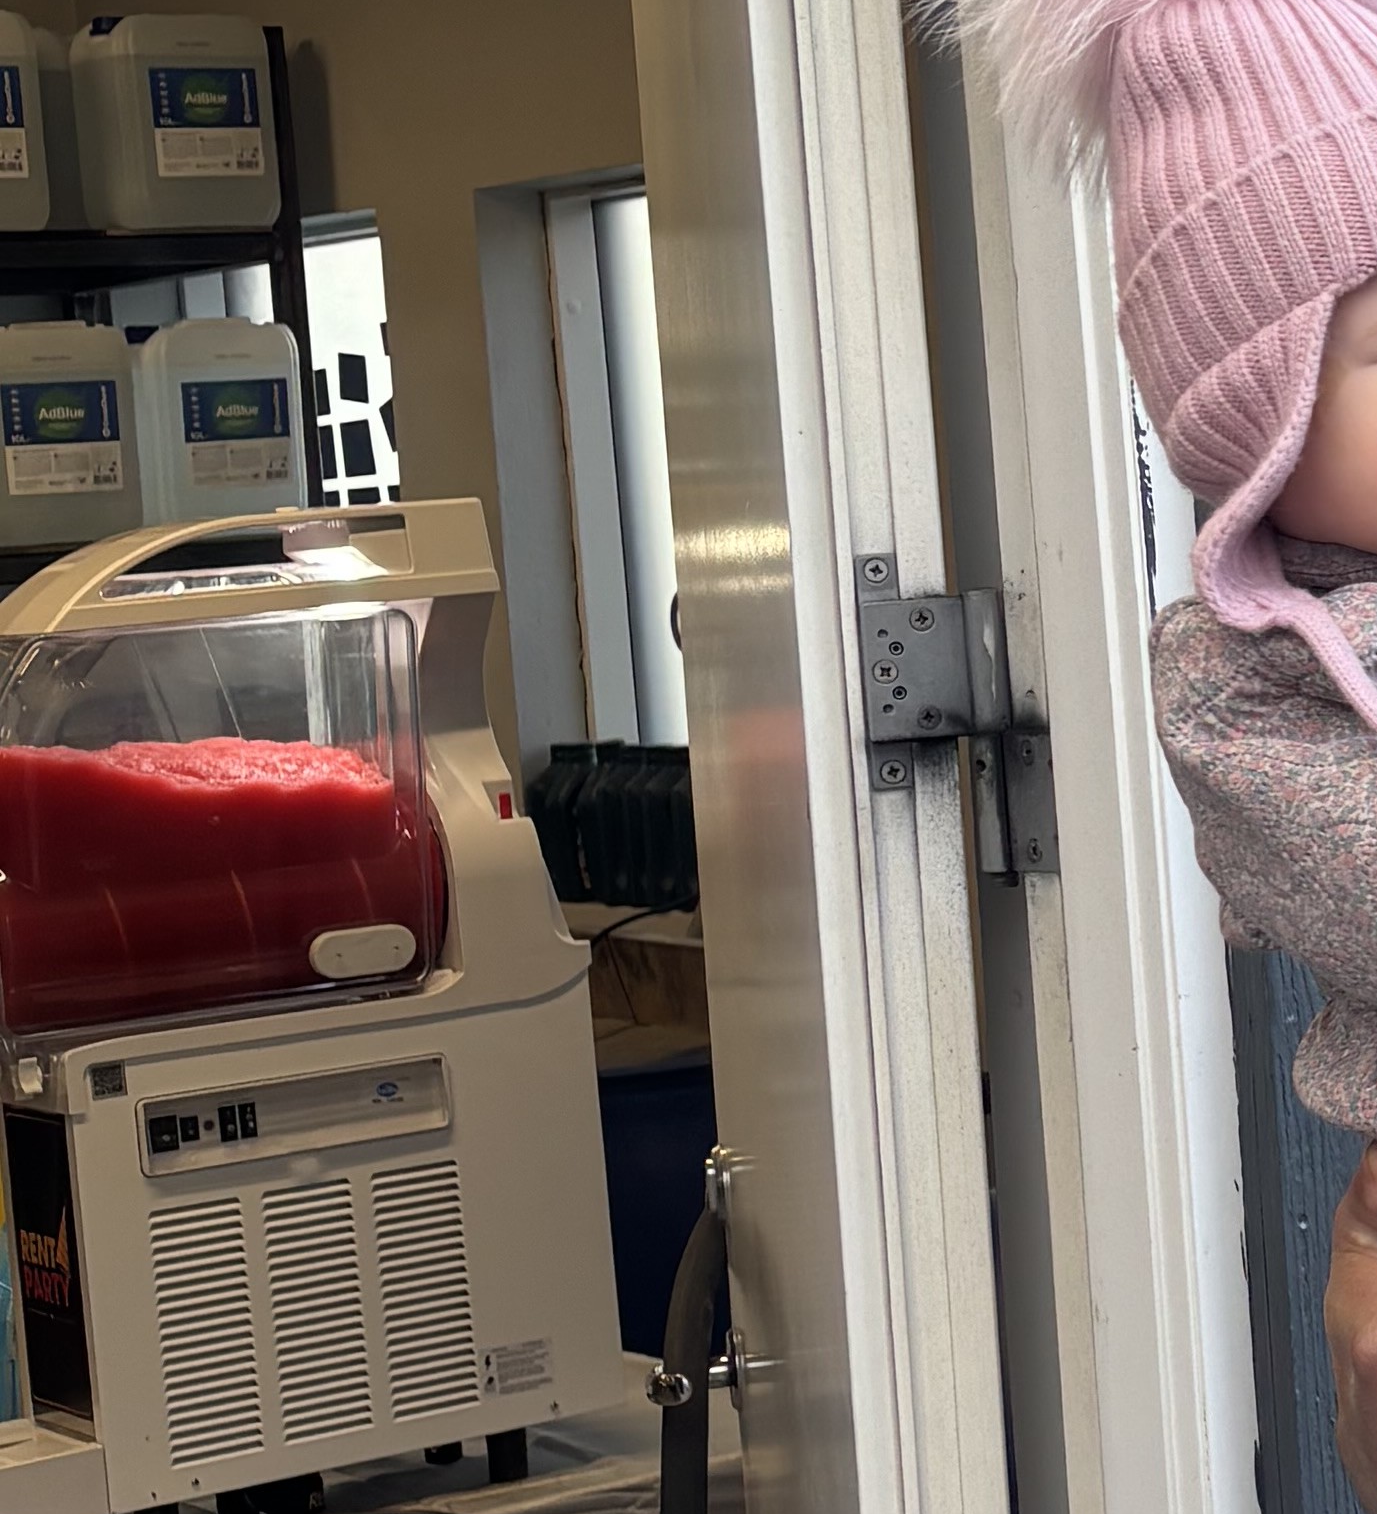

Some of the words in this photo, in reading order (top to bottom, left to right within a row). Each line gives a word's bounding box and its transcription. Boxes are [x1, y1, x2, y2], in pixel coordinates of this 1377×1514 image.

[185, 92, 228, 104] AdBlue
[39, 407, 85, 420] AdBlue
[216, 405, 259, 418] AdBlue
[24, 1265, 69, 1307] PARTY
